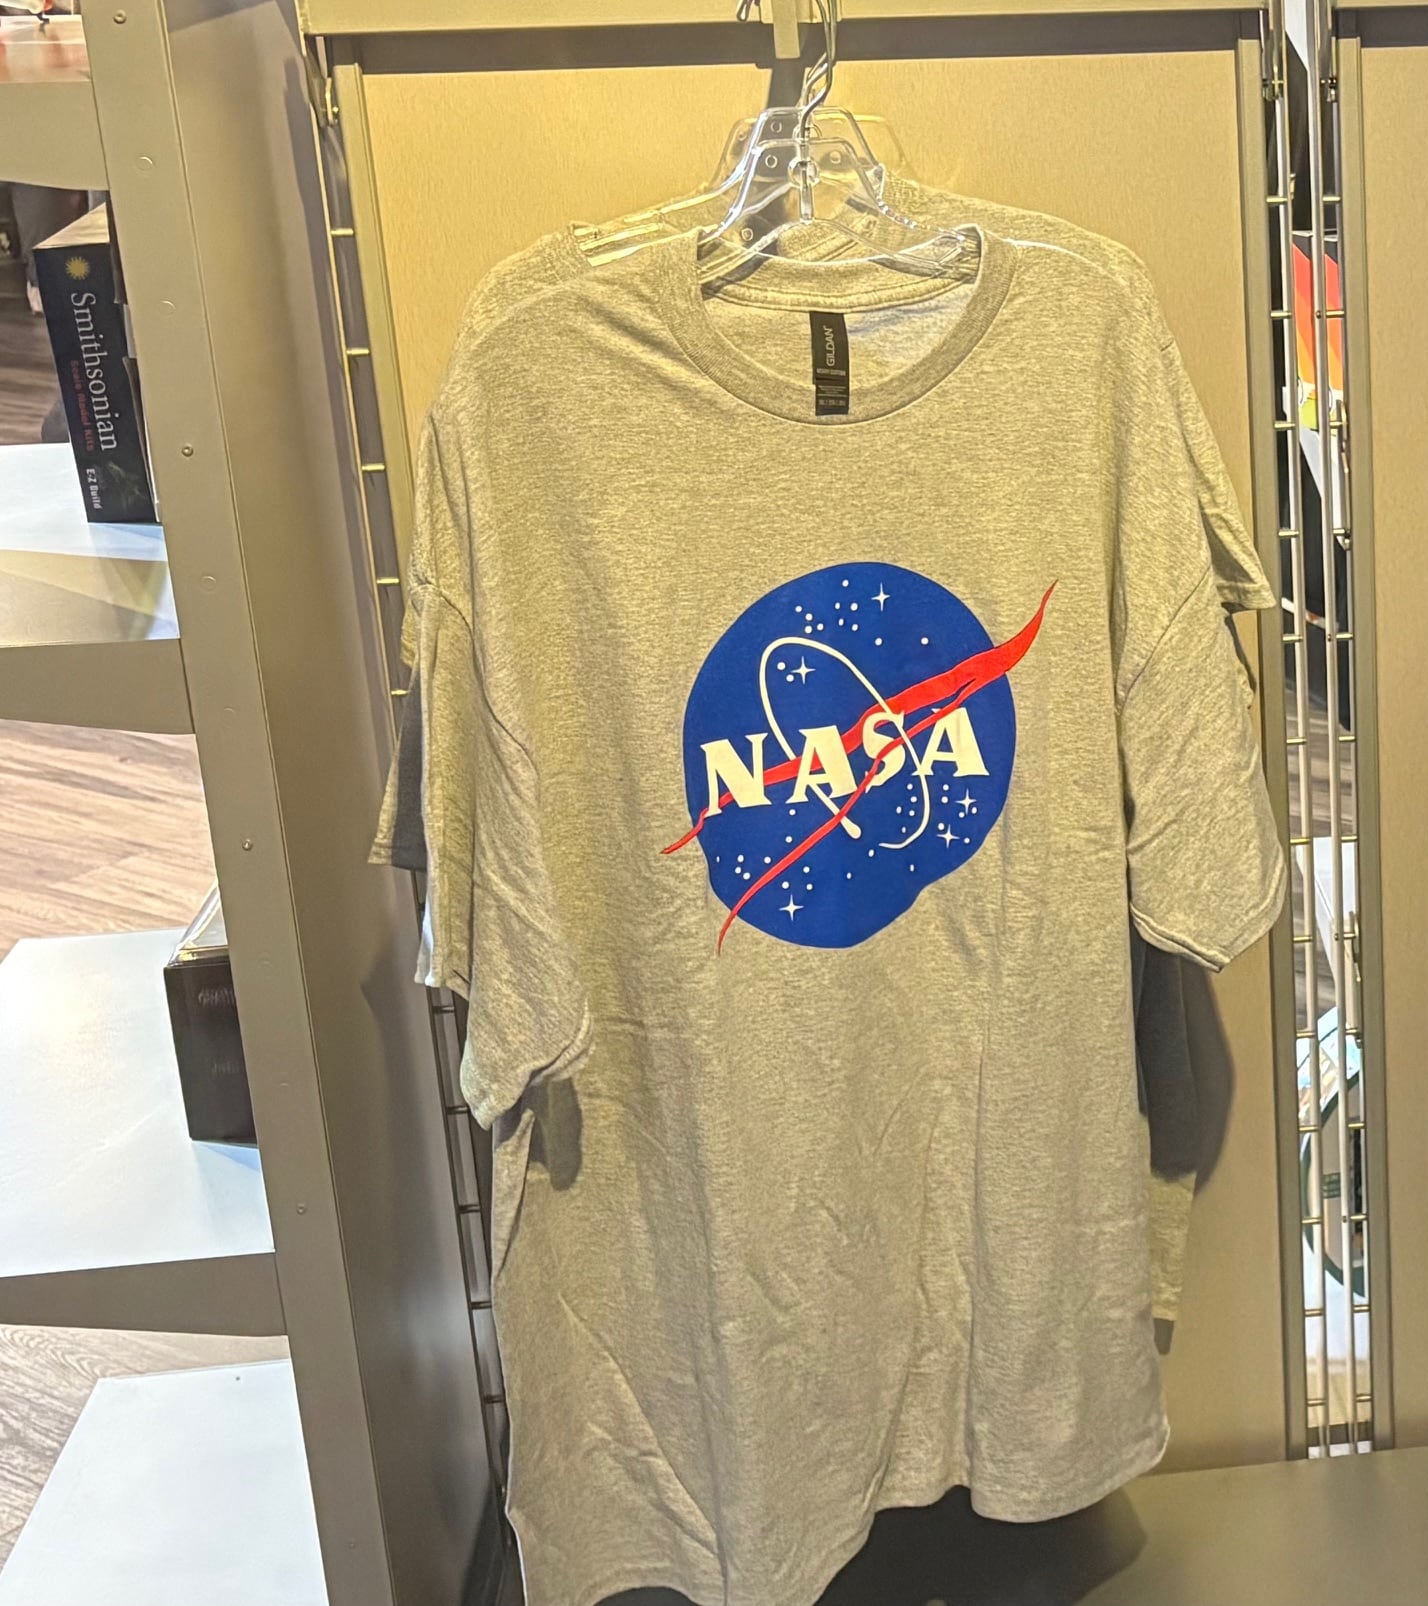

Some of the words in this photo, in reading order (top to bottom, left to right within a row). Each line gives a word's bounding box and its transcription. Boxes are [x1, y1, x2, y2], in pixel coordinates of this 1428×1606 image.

[71, 292, 119, 451] Smithsonian
[823, 326, 836, 367] GILDAN
[700, 707, 990, 817] NASA
